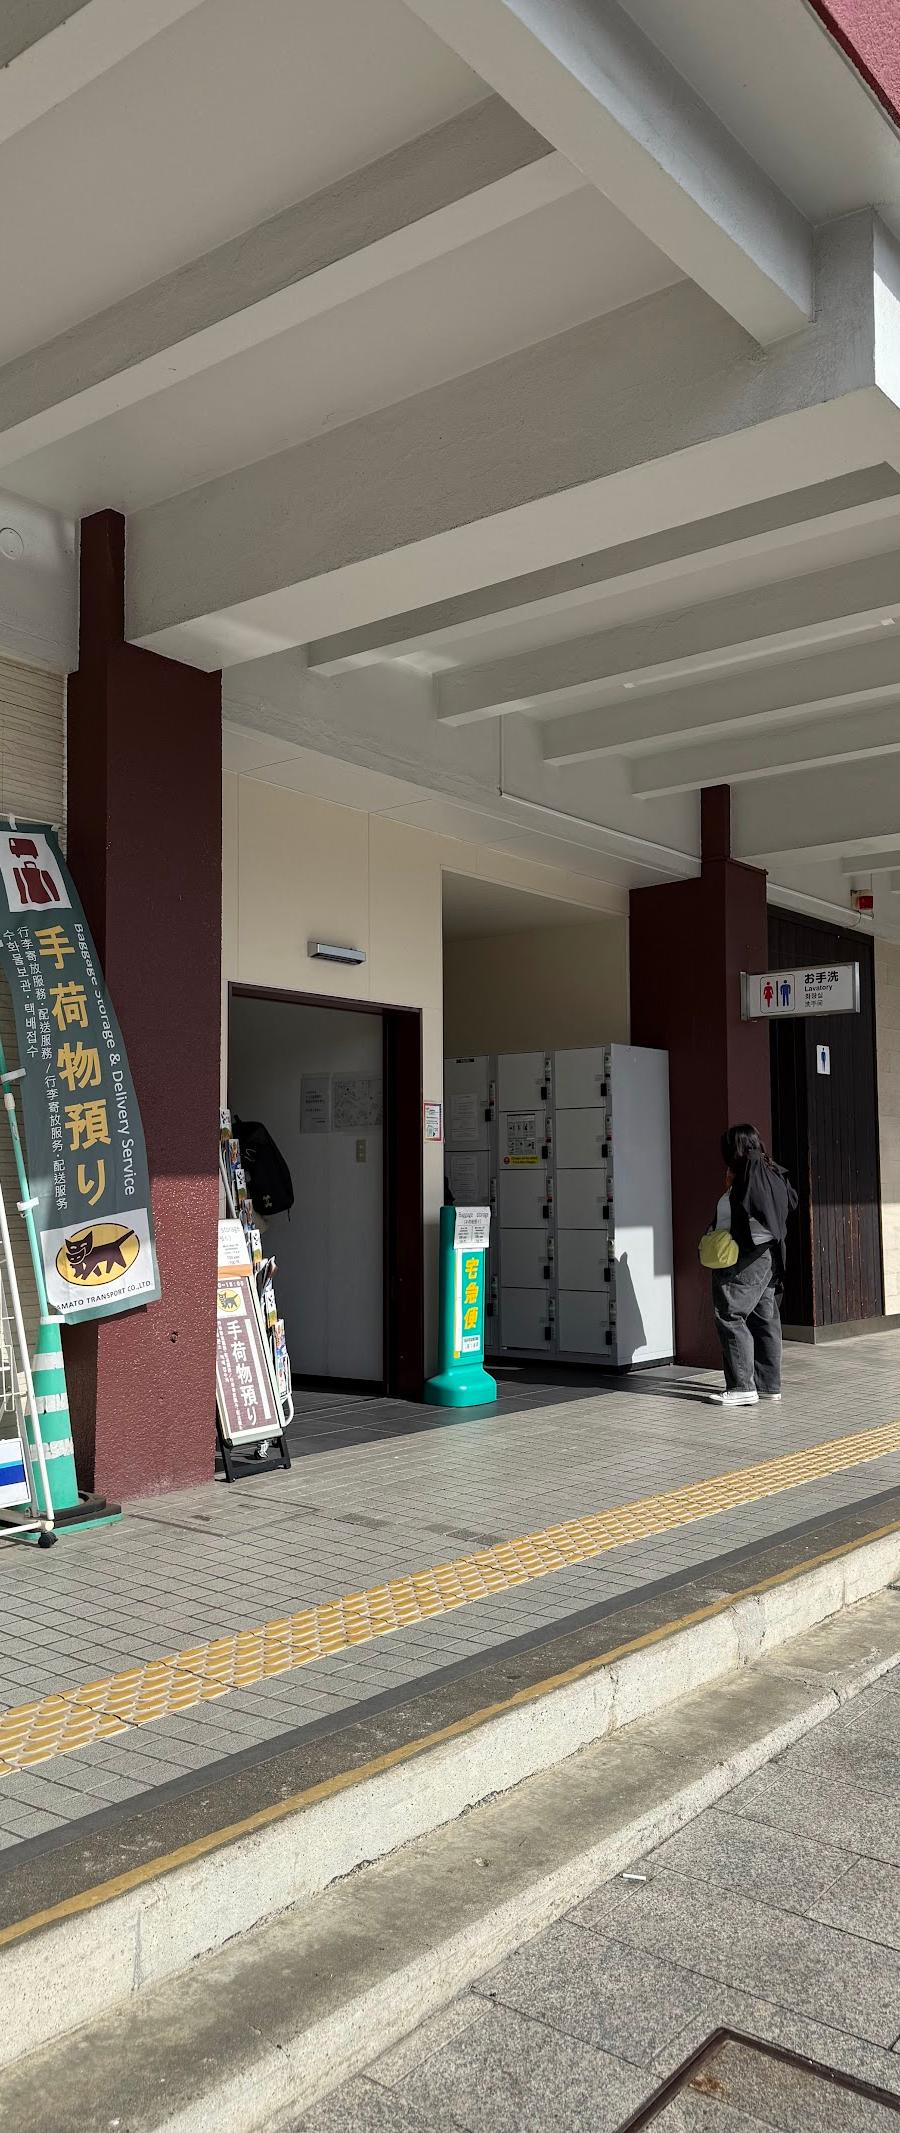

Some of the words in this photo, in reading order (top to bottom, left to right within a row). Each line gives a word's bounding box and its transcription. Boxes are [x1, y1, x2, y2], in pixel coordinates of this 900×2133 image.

[74, 923, 98, 986] Baggage
[804, 970, 839, 984] お手洗
[34, 925, 112, 1206] 手荷物預り
[109, 1053, 121, 1067] &
[112, 1069, 130, 1135] Delivery
[121, 1138, 135, 1196] Service
[55, 1299, 84, 1310] AMATO
[86, 1287, 125, 1304] TRANSPORT
[464, 1257, 480, 1330] 宅急便
[226, 1319, 258, 1426] 手荷物預り
